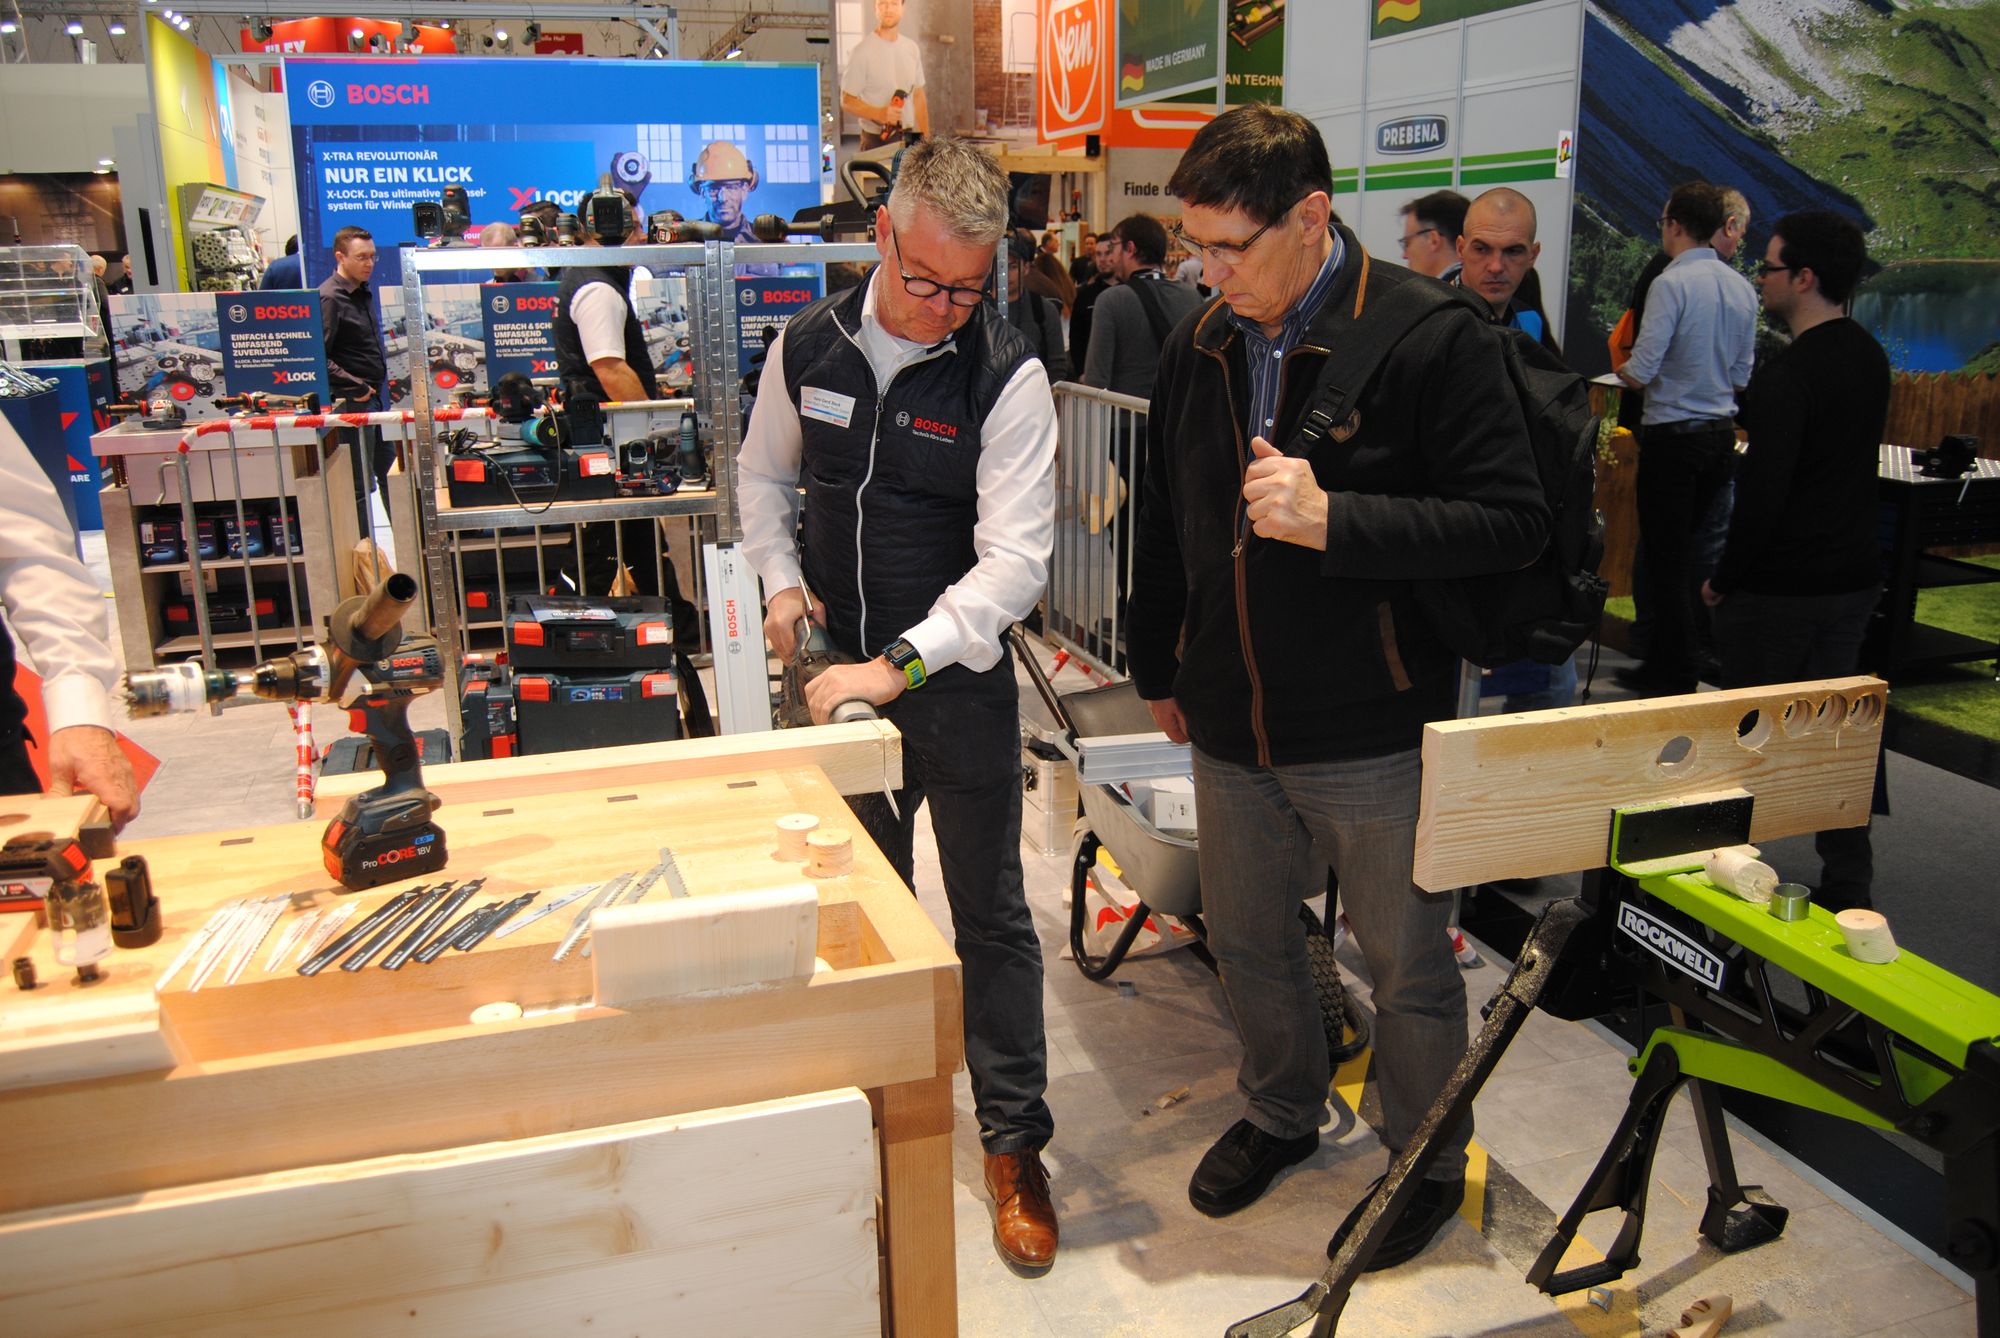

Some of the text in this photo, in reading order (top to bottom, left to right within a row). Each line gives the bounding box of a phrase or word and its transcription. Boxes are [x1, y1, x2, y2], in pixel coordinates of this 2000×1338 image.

[1146, 43, 1206, 72] MADE IN GERMANY
[347, 84, 430, 105] BOSCH
[1383, 122, 1440, 147] PREBENA
[323, 149, 438, 160] X-TRA REVOLUTIONÄR
[325, 166, 474, 184] NUR EIN KLICK
[326, 190, 368, 199] X-LOCK.
[370, 189, 390, 198] Das
[392, 188, 440, 198] ultimative
[1124, 182, 1160, 196] Finde
[328, 201, 362, 212] system
[365, 200, 380, 210] für
[762, 290, 812, 304] BOSCH
[254, 305, 310, 320] BOSCH
[230, 332, 266, 341] EINFACH
[495, 338, 548, 346] ZUVERLÄSSIG
[232, 340, 282, 348] UMFASSEND
[232, 348, 289, 356] ZUVERLÄSSIG
[914, 416, 957, 438] BOSCH
[726, 600, 738, 638] BOSCH
[392, 656, 424, 668] BOSCH
[1624, 910, 1714, 980] ROCKWELL
